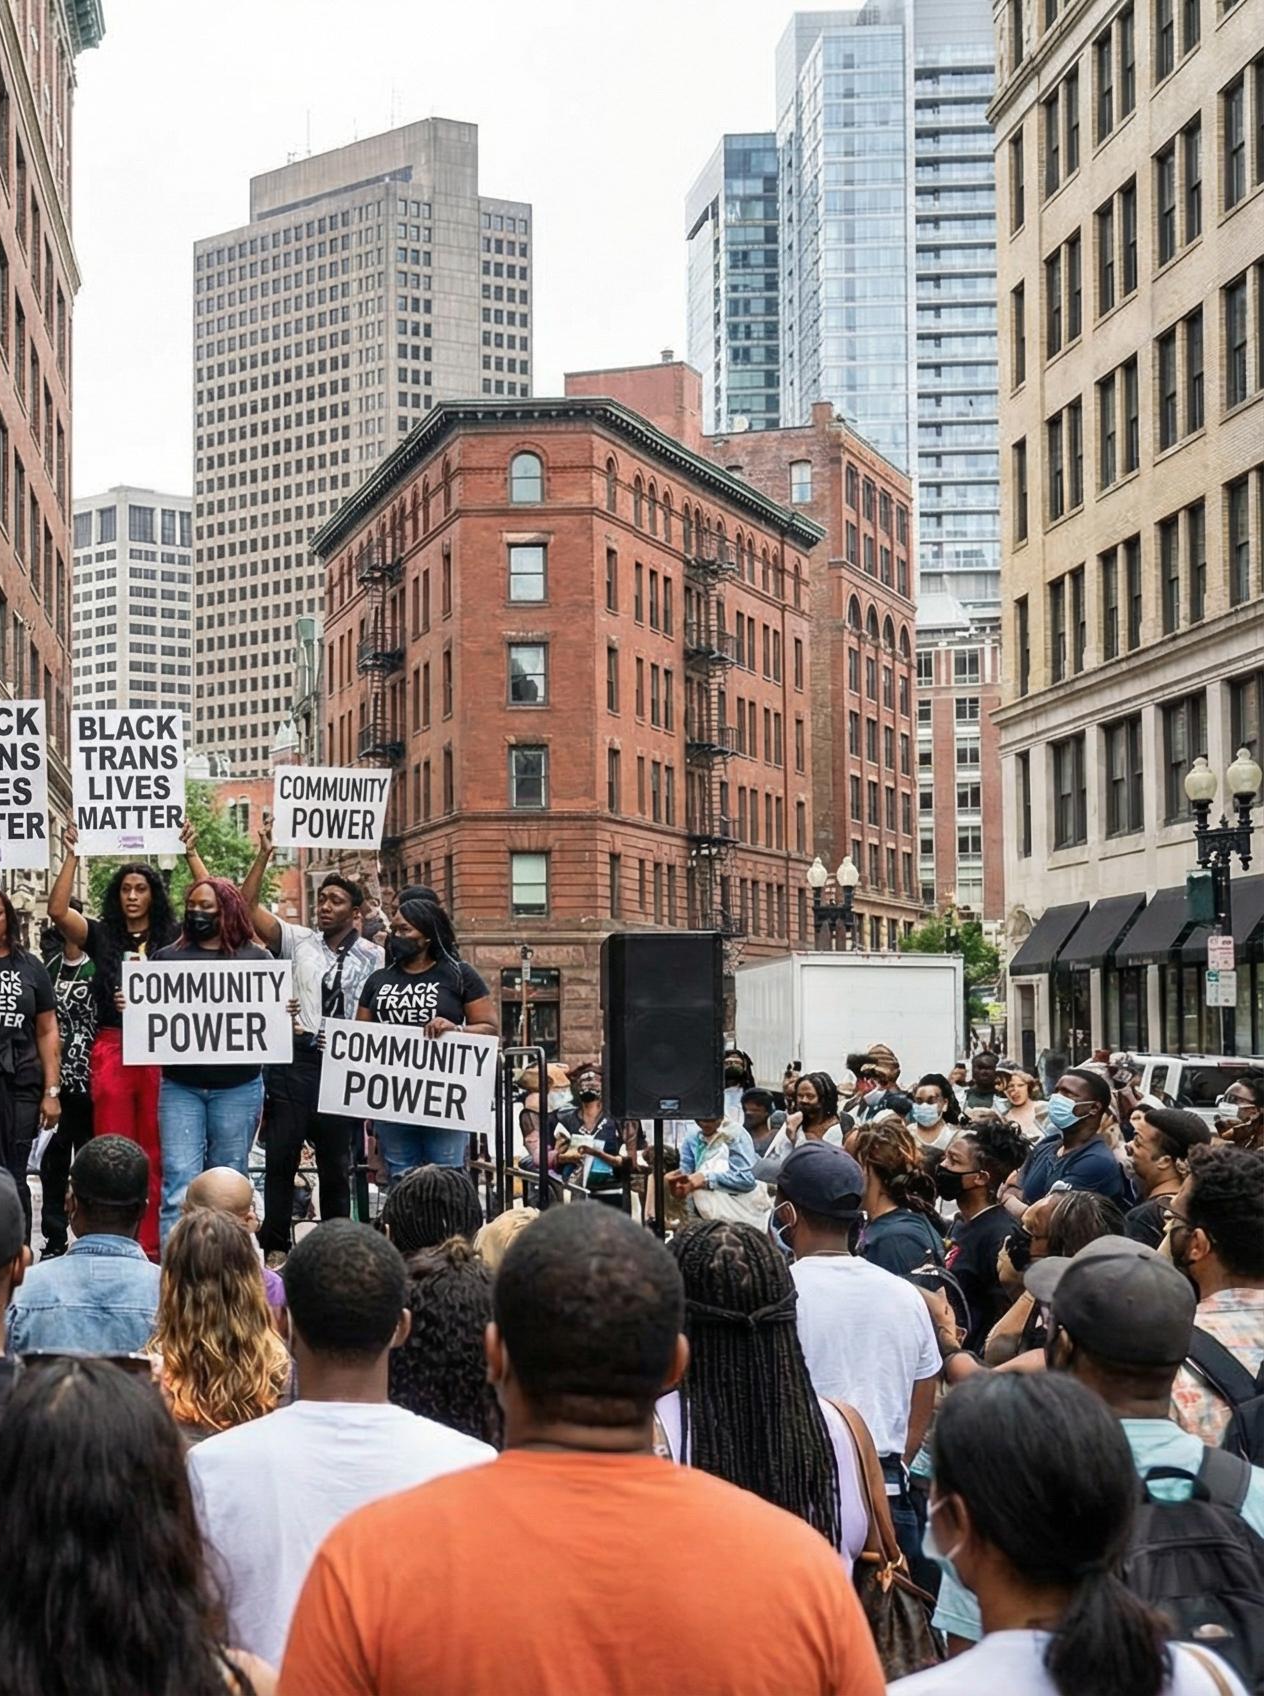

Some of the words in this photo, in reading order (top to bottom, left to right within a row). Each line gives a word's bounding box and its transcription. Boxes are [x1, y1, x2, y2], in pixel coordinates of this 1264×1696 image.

[78, 715, 177, 740] BLACK
[79, 745, 178, 770] TRANS
[89, 775, 170, 800] LIVES
[280, 776, 387, 803] COMMUNITY
[78, 805, 184, 830] MATTER
[292, 808, 374, 840] POWER
[129, 971, 285, 1005] COMMUNITY
[378, 982, 440, 996] BLACK
[376, 994, 438, 1010] TRANS
[148, 1012, 267, 1052] POWER
[331, 1030, 489, 1076] COMMUNITY
[344, 1071, 466, 1121] POWER
